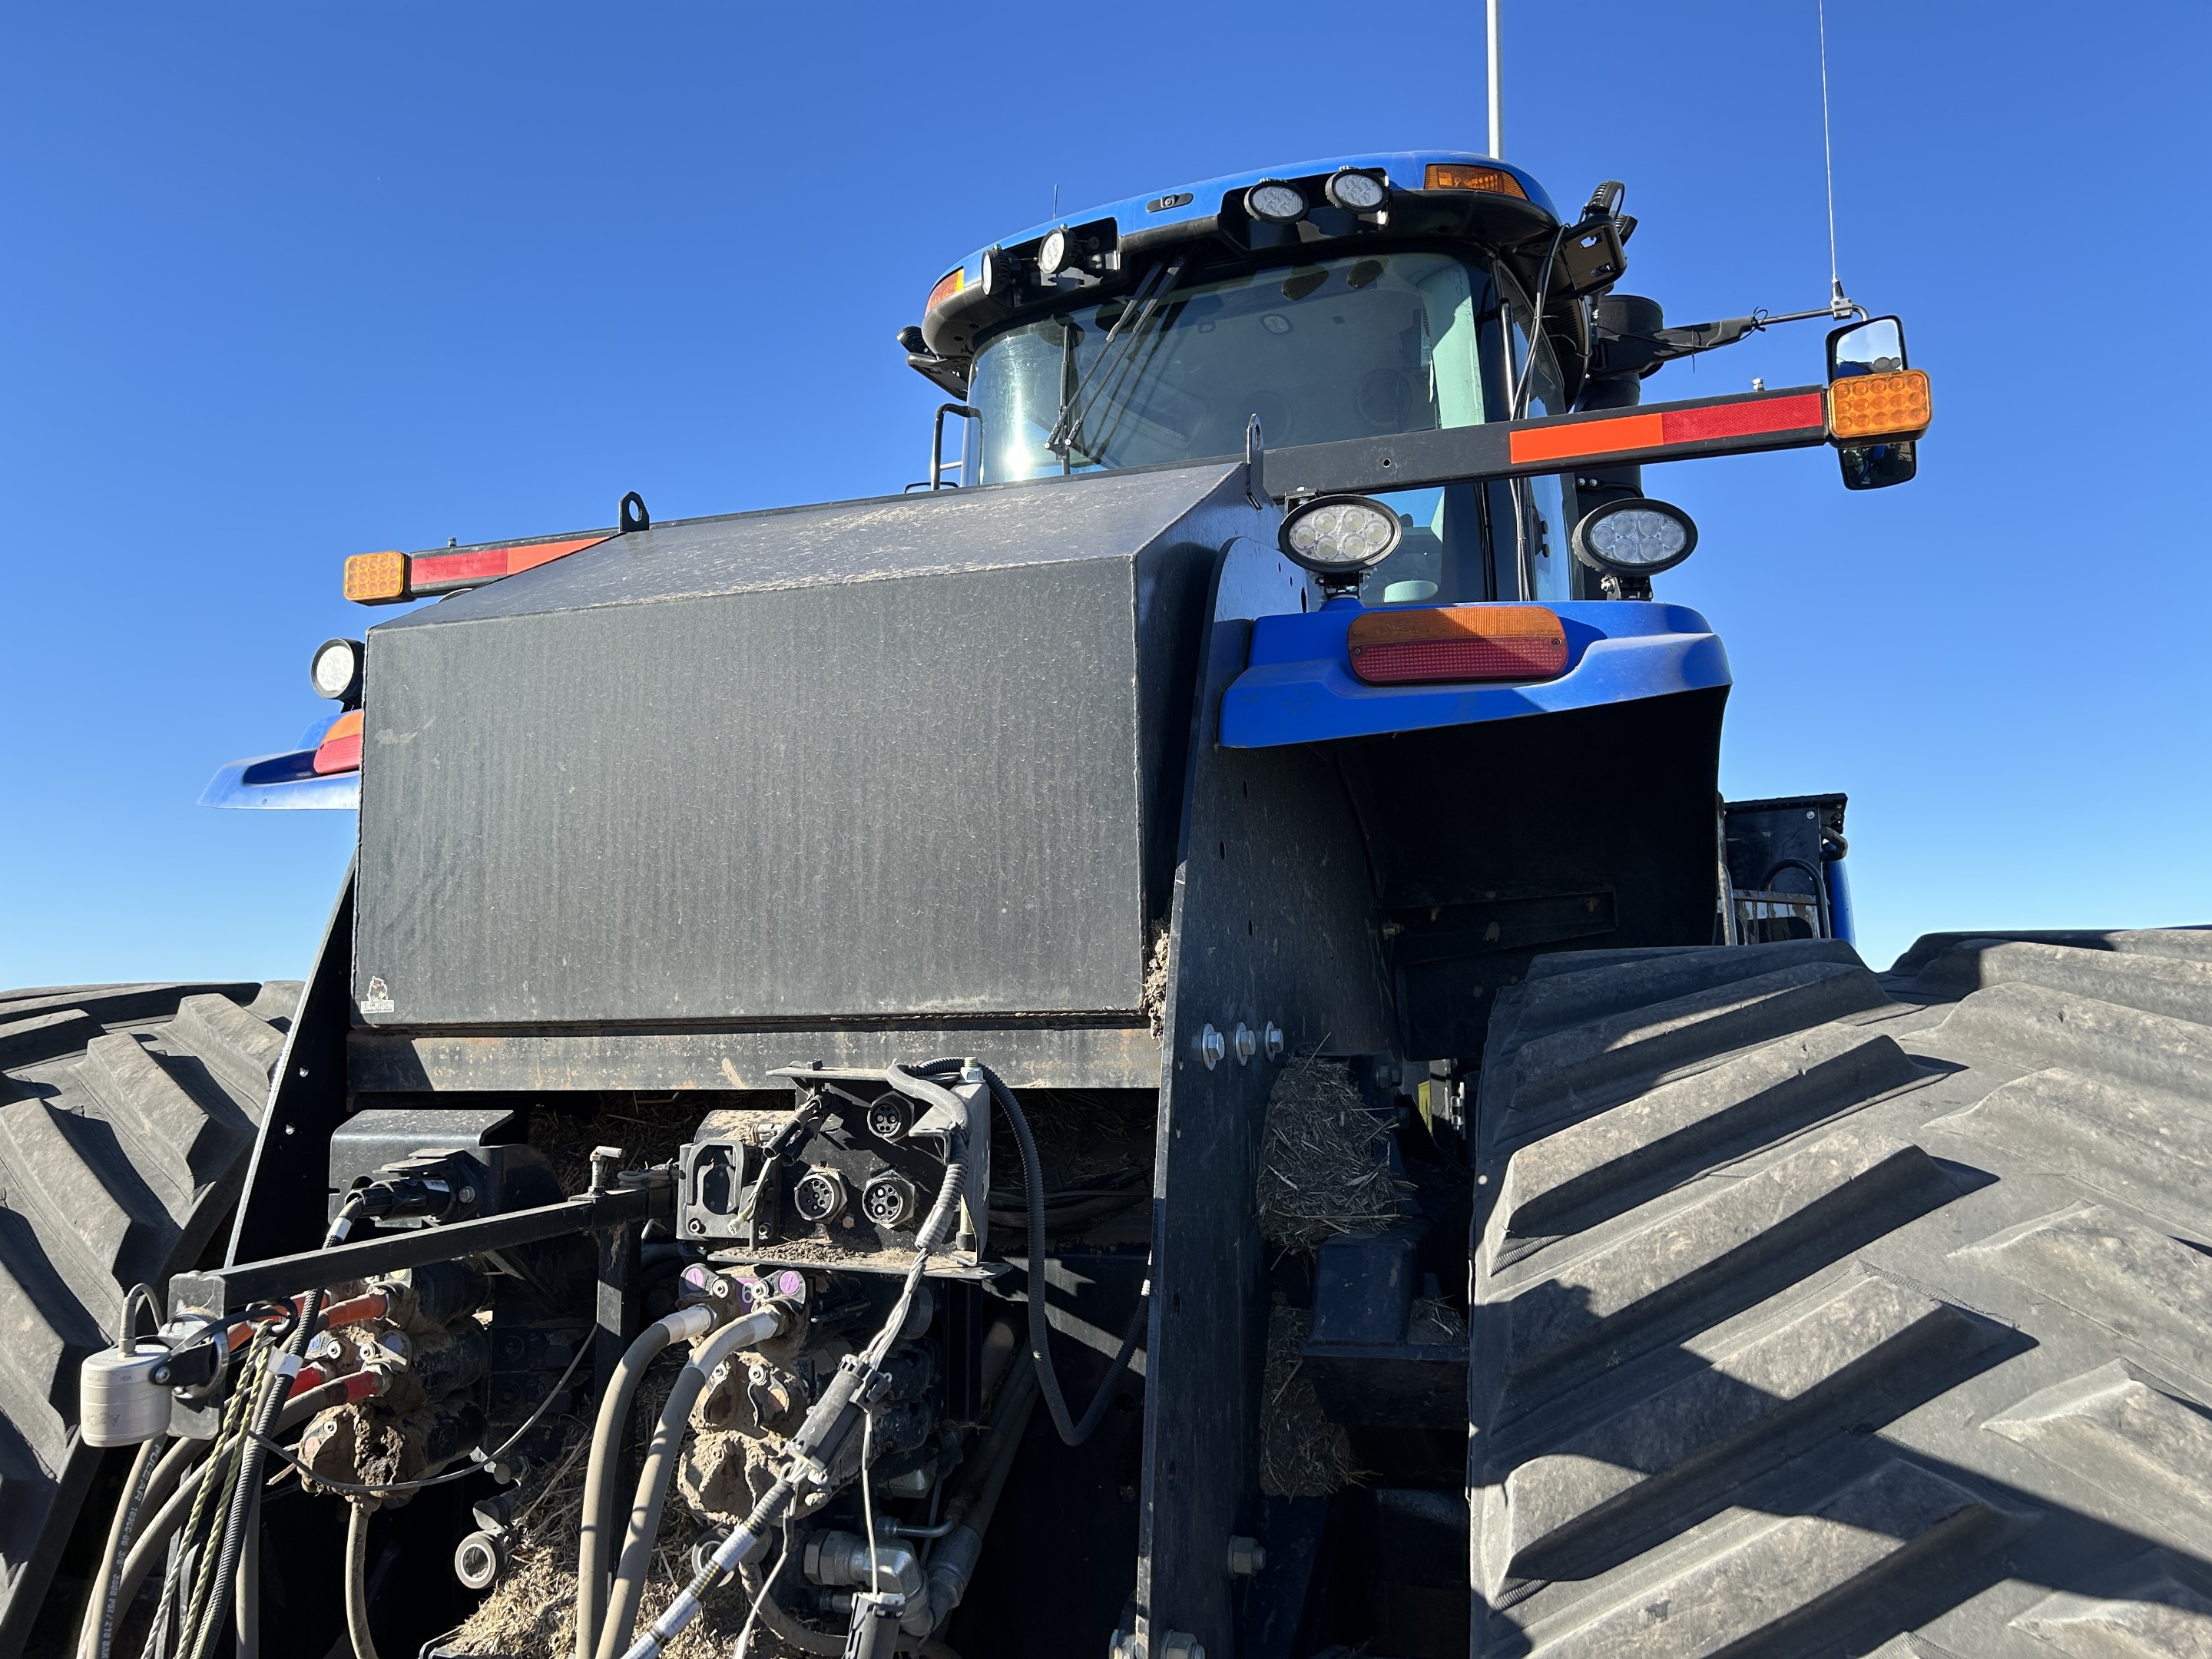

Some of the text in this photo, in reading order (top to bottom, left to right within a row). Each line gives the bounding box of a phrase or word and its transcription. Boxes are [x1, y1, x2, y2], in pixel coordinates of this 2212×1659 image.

[742, 1282, 753, 1303] 6
[134, 1444, 161, 1502] PULSAR
[110, 1573, 121, 1596] 3000
[106, 1598, 117, 1613] PSI
[102, 1621, 113, 1638] 210
